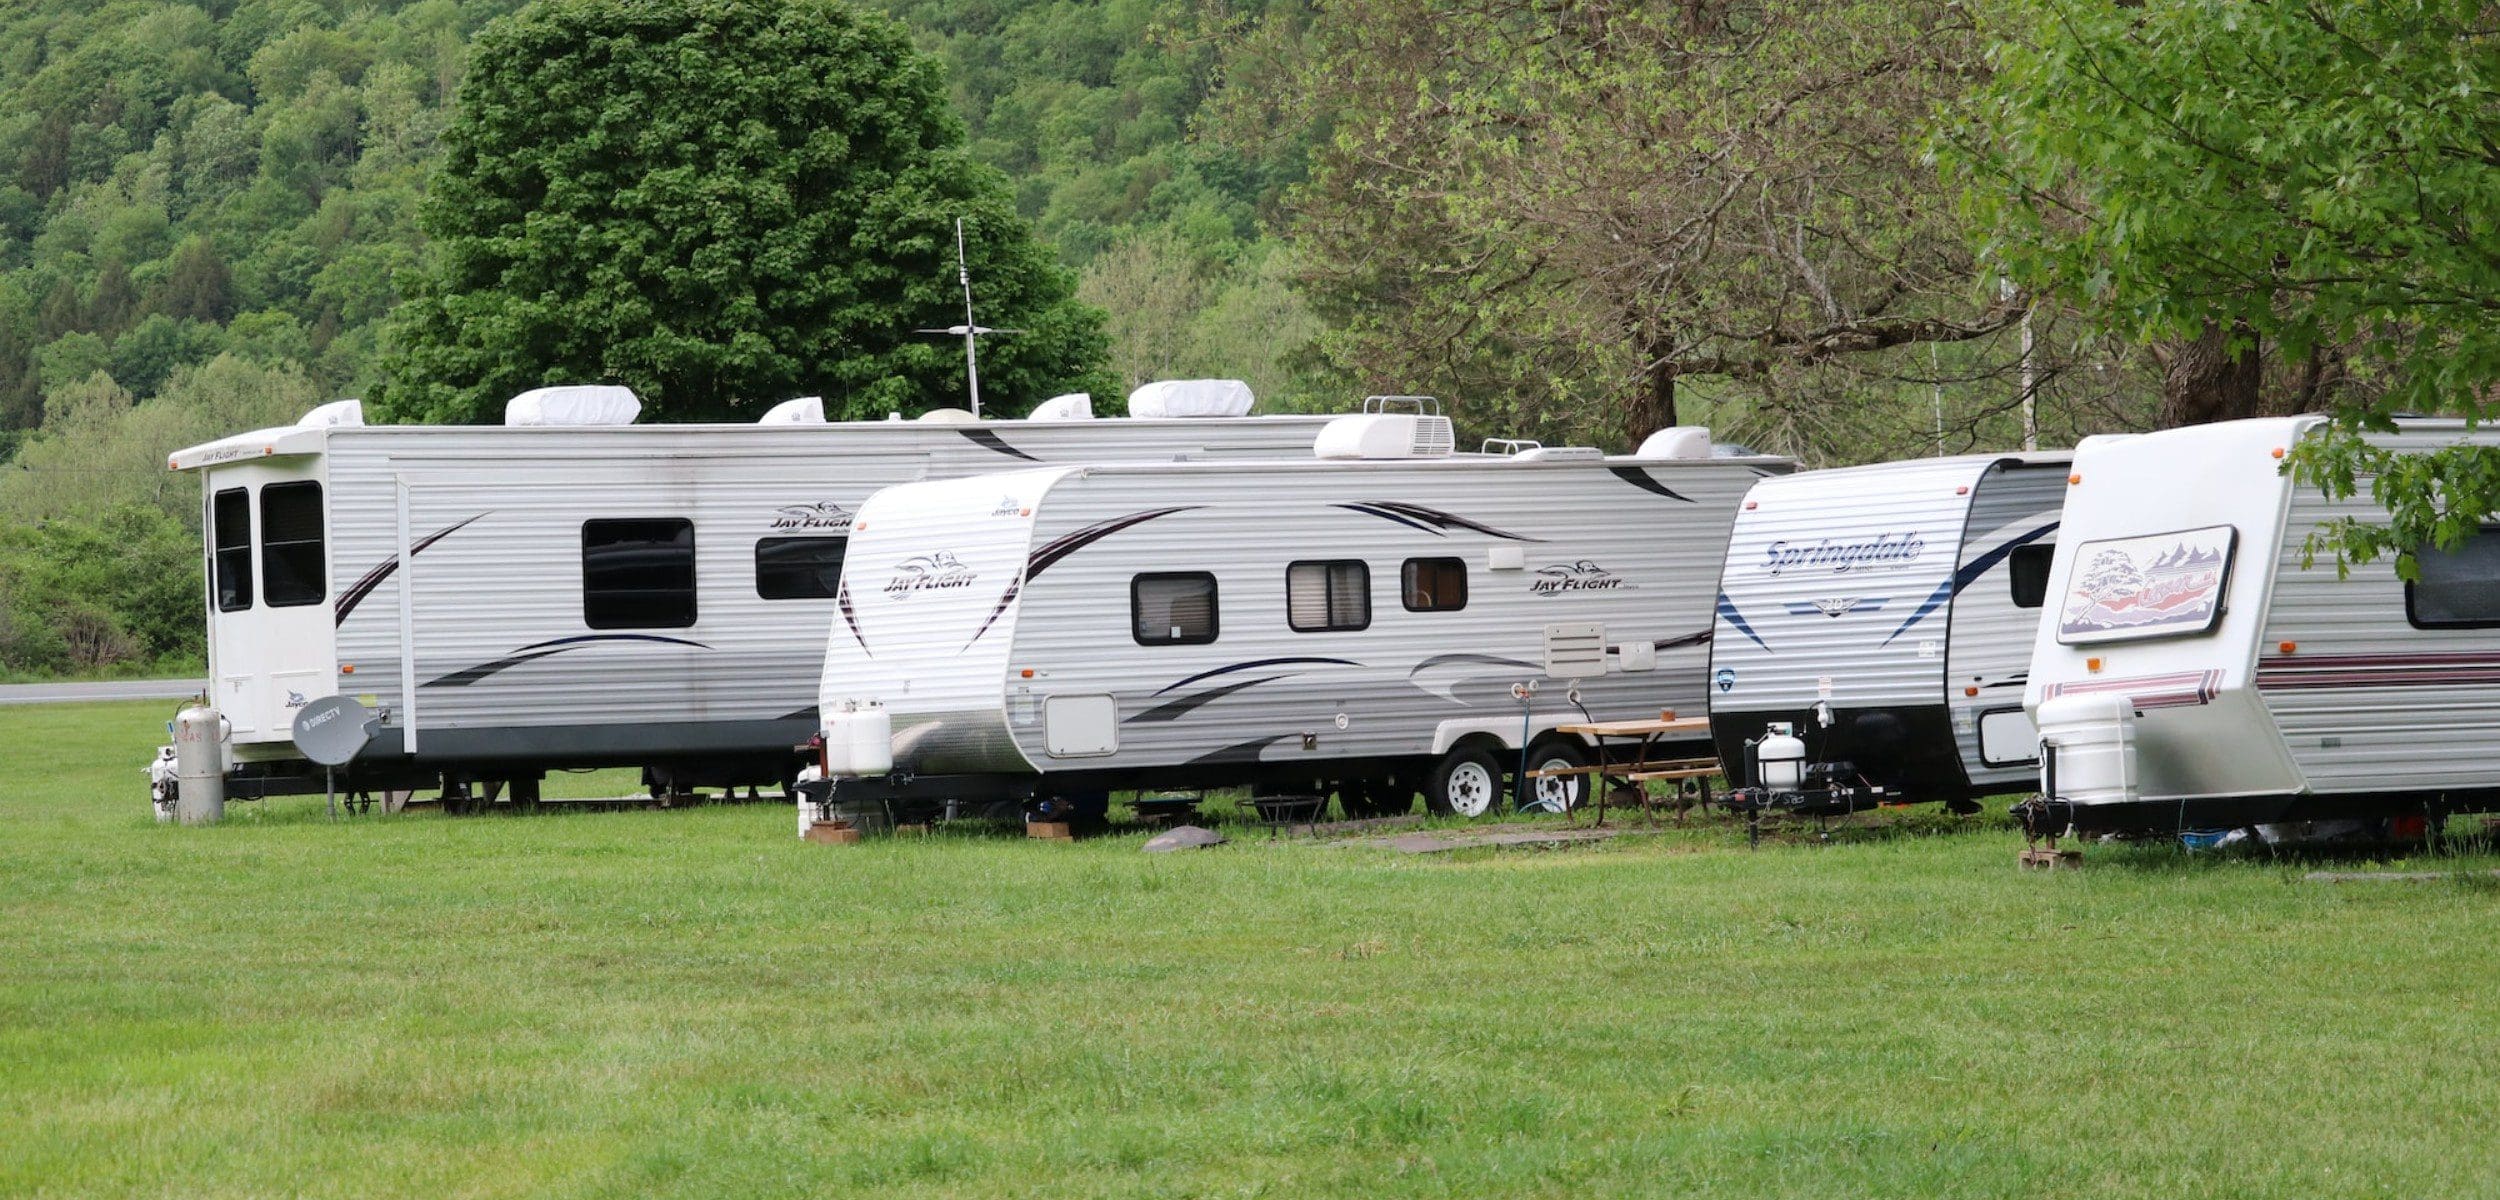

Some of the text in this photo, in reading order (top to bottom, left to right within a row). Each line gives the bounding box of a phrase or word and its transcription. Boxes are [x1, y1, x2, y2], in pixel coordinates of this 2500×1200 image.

[770, 517, 853, 528] JAY FLIGH
[1760, 531, 1924, 577] Springdale
[884, 574, 978, 592] JAY FLIGHT
[1530, 580, 1560, 592] JAY
[1561, 578, 1622, 590] FLIGHT
[309, 705, 341, 728] DIRECTV
